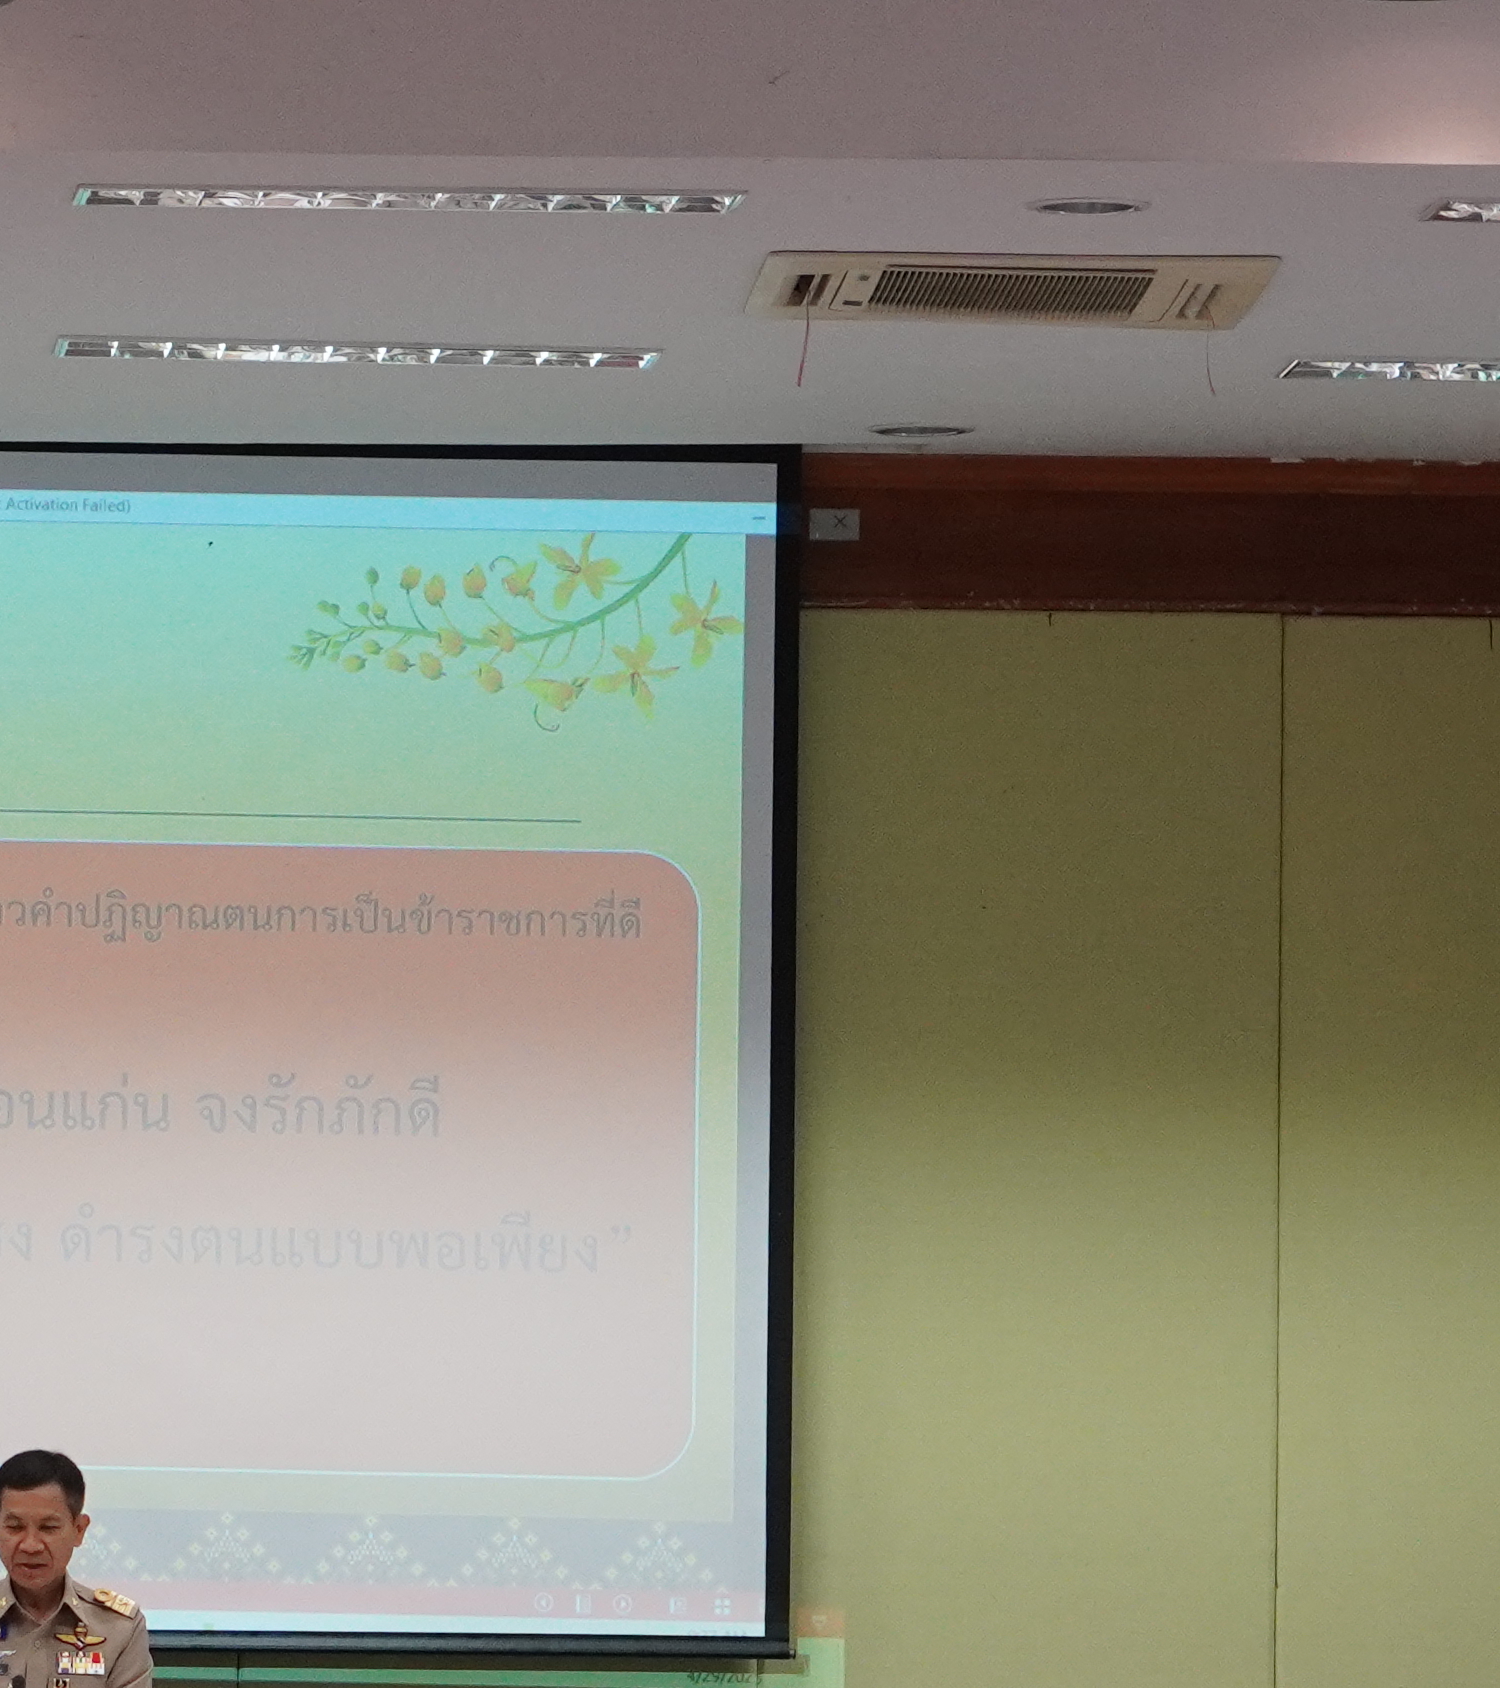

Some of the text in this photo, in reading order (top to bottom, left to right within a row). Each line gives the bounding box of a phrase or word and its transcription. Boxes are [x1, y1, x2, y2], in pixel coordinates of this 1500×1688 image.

[5, 496, 79, 513] Activation
[83, 497, 131, 515] Failed)
[198, 1072, 442, 1138] จงรักภักดี
